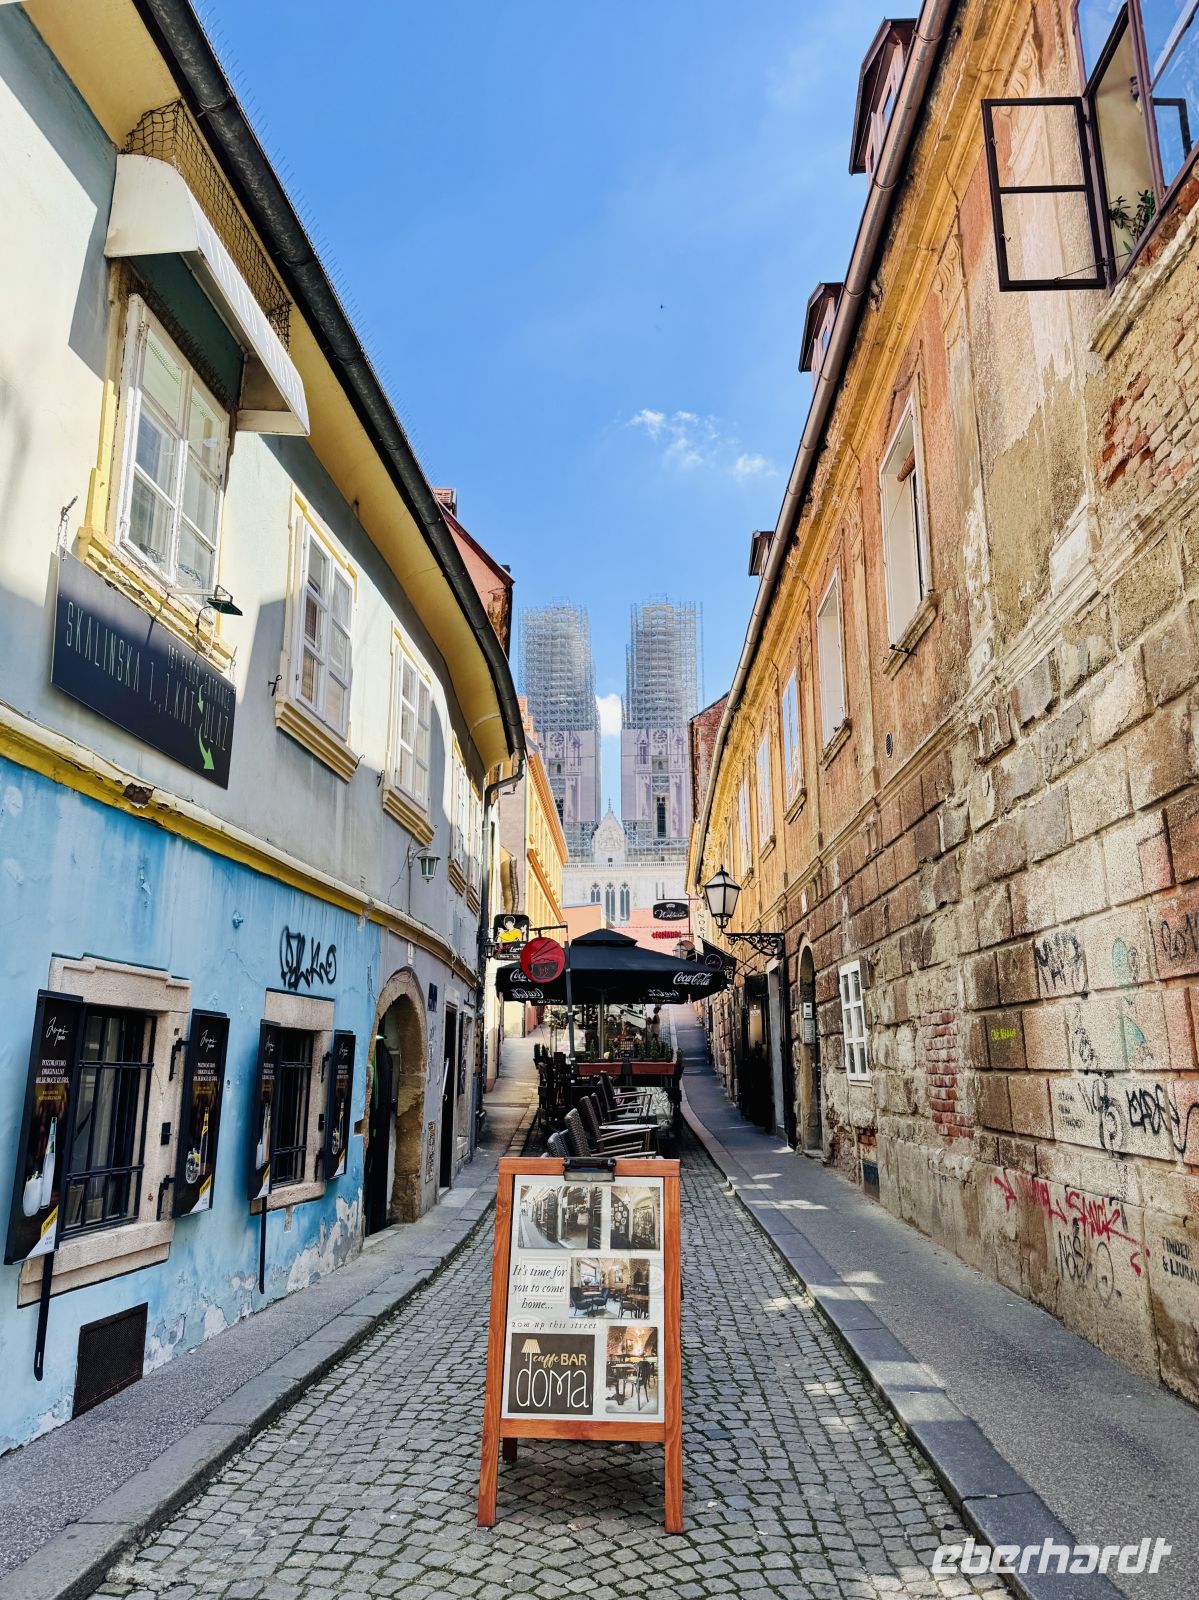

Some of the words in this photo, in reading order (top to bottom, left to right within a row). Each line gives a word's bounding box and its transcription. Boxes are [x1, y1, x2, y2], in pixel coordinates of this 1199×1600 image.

[66, 601, 141, 693] SKALINSKA
[203, 702, 229, 751] ULAZ
[512, 1264, 528, 1277] It's
[529, 1266, 551, 1277] time
[550, 1265, 567, 1280] for
[511, 1284, 529, 1296] you
[530, 1283, 540, 1293] to
[541, 1284, 565, 1293] come
[521, 1297, 553, 1310] home...
[534, 1321, 545, 1331] up
[549, 1320, 566, 1329] this
[570, 1321, 597, 1329] street
[532, 1353, 560, 1369] caffe
[560, 1353, 587, 1366] BAR
